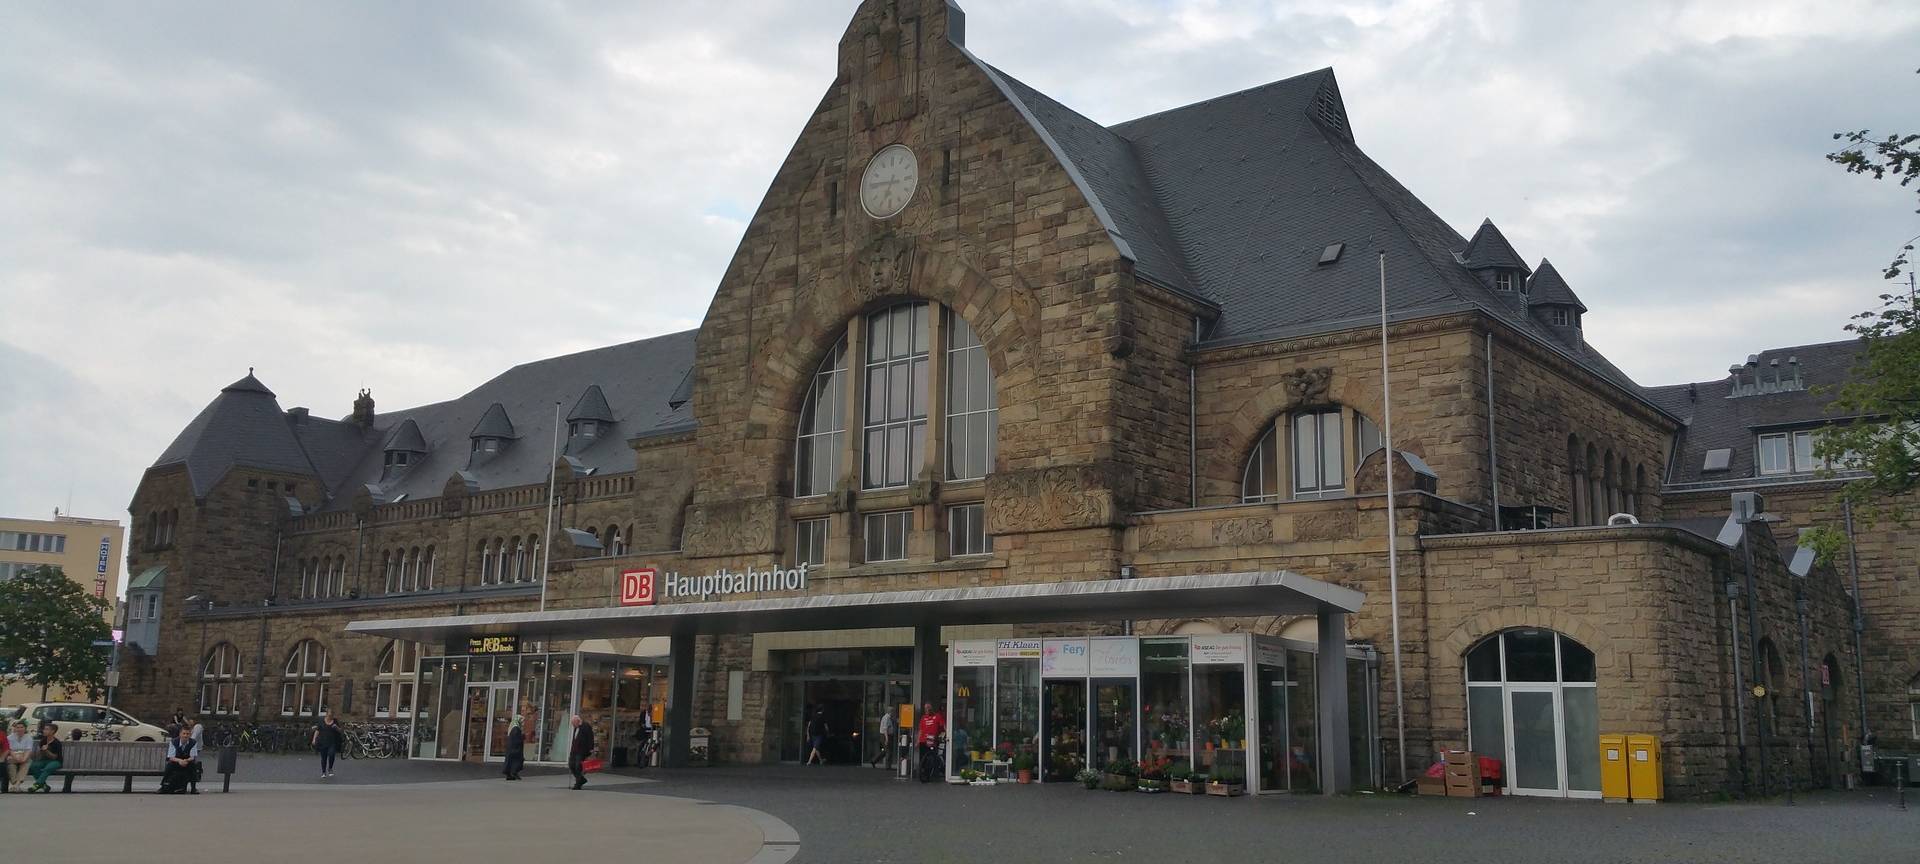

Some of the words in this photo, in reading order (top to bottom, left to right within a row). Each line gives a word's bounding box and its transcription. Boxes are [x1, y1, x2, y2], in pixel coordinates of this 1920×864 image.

[624, 574, 651, 600] DB
[664, 561, 807, 601] Hauptbahnhof
[1062, 644, 1086, 657] Fery
